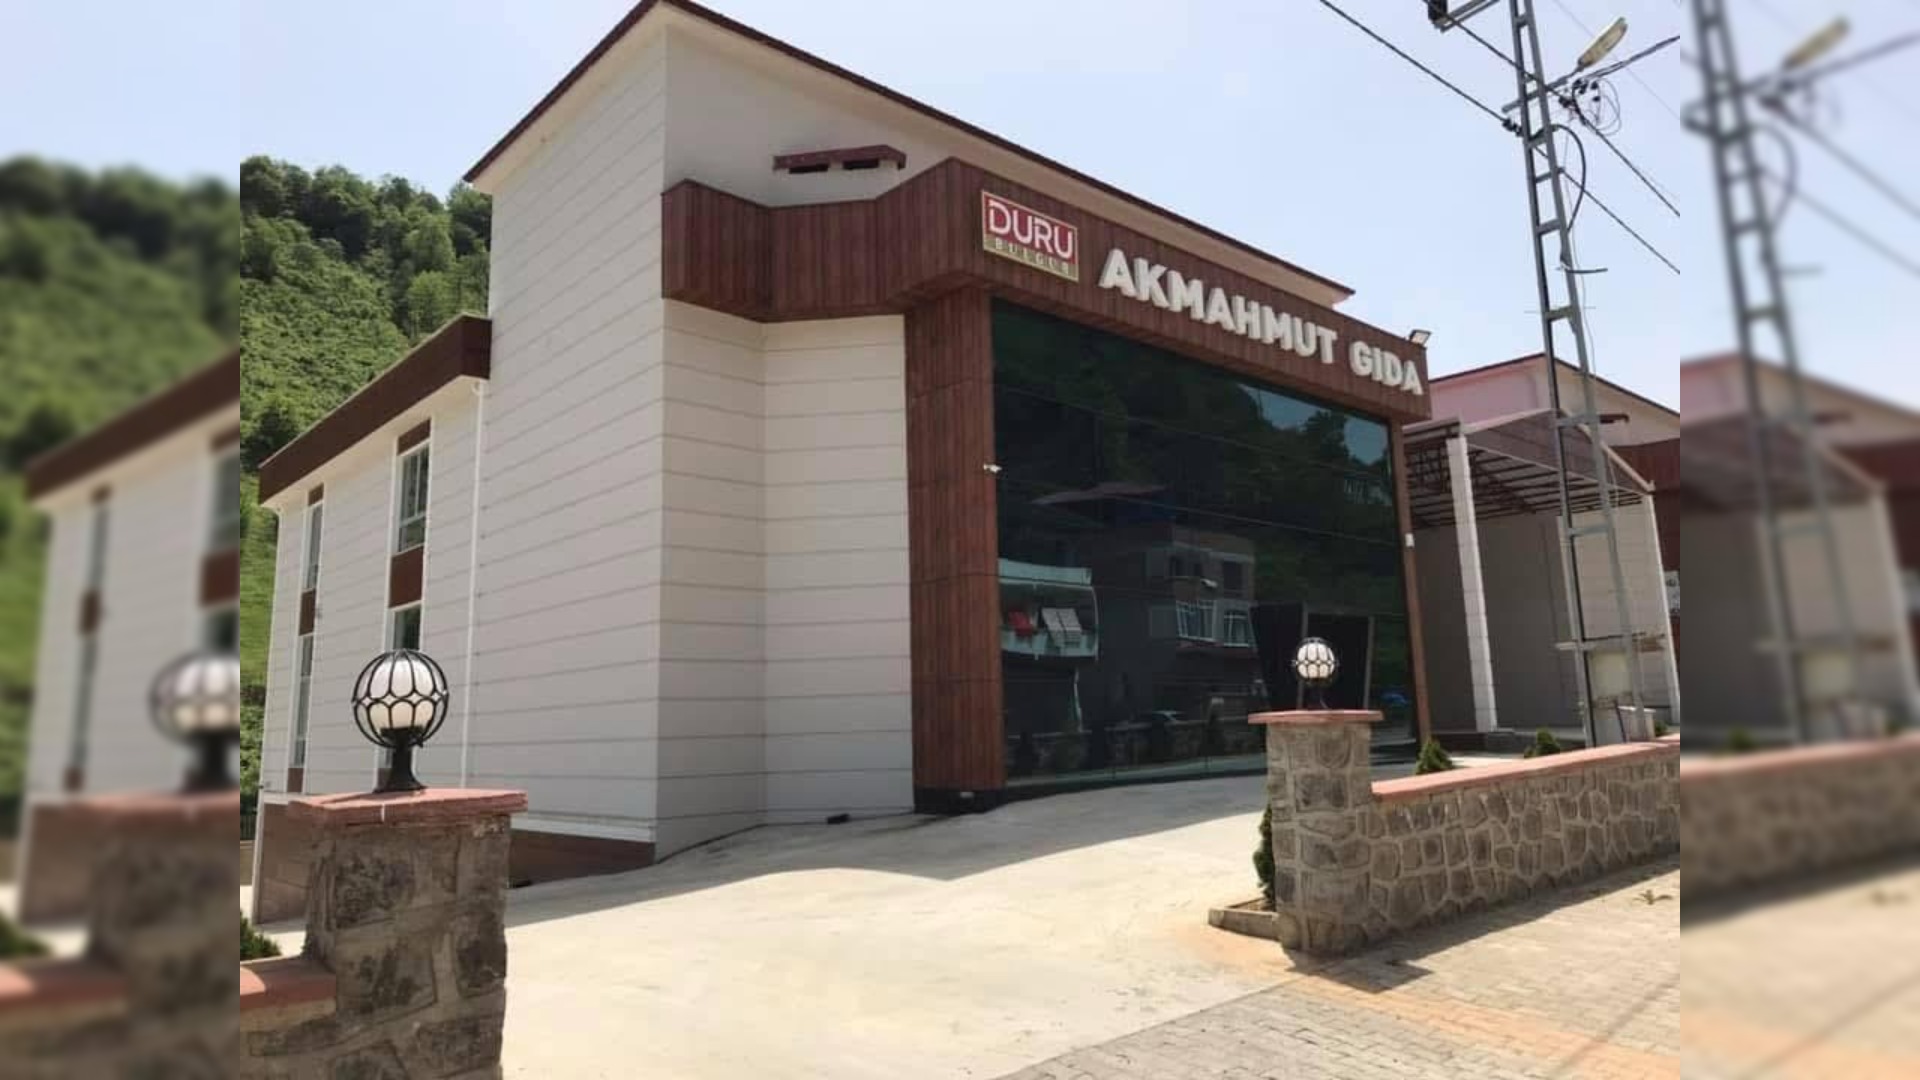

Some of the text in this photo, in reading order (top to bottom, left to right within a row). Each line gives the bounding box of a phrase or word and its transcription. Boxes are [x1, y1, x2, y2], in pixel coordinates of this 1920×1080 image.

[988, 199, 1073, 259] DURU
[1098, 248, 1424, 396] AKMAHMUT GIDA
